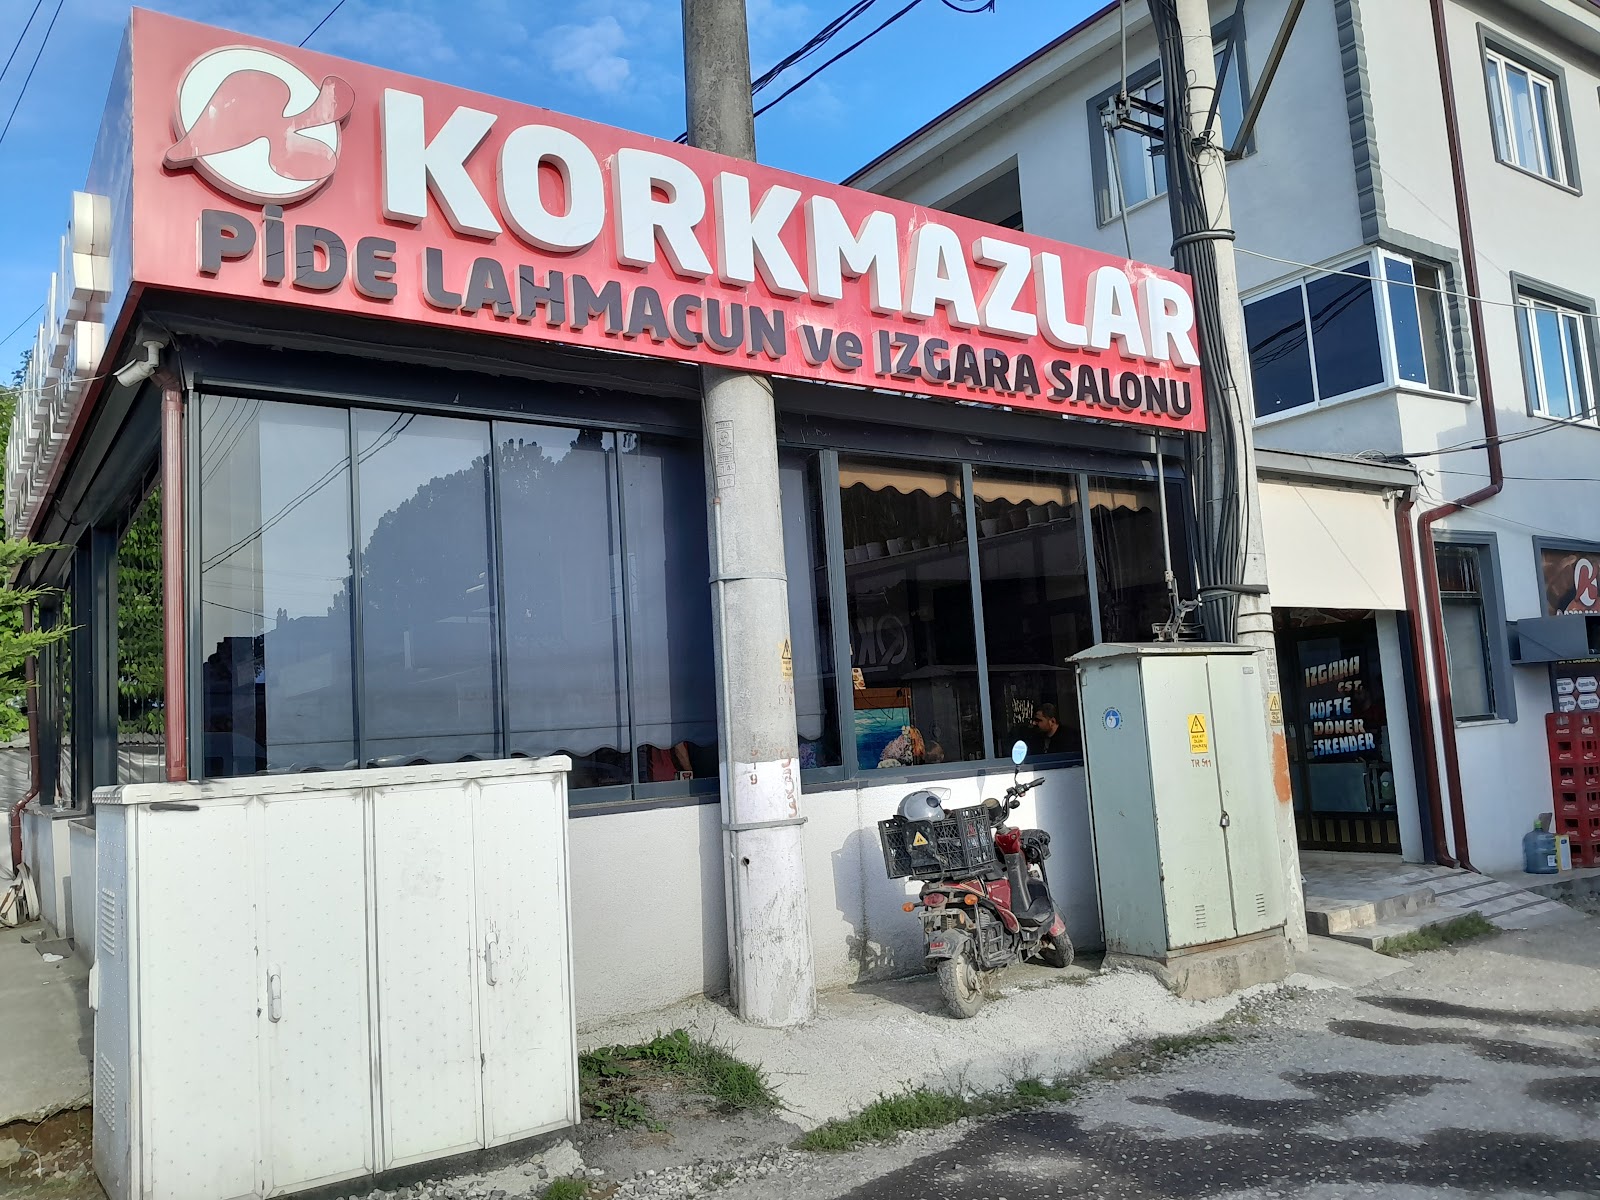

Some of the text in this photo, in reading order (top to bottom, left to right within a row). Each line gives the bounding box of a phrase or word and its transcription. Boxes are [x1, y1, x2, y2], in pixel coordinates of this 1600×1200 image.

[380, 86, 1200, 370] KORKMAZLAR
[197, 204, 1192, 418] PİDE LAHMACUN ve IZGARA SALONU
[1304, 656, 1360, 688] IZGARA
[1309, 697, 1352, 720] KÖFTE
[1313, 719, 1366, 736] DÖNER
